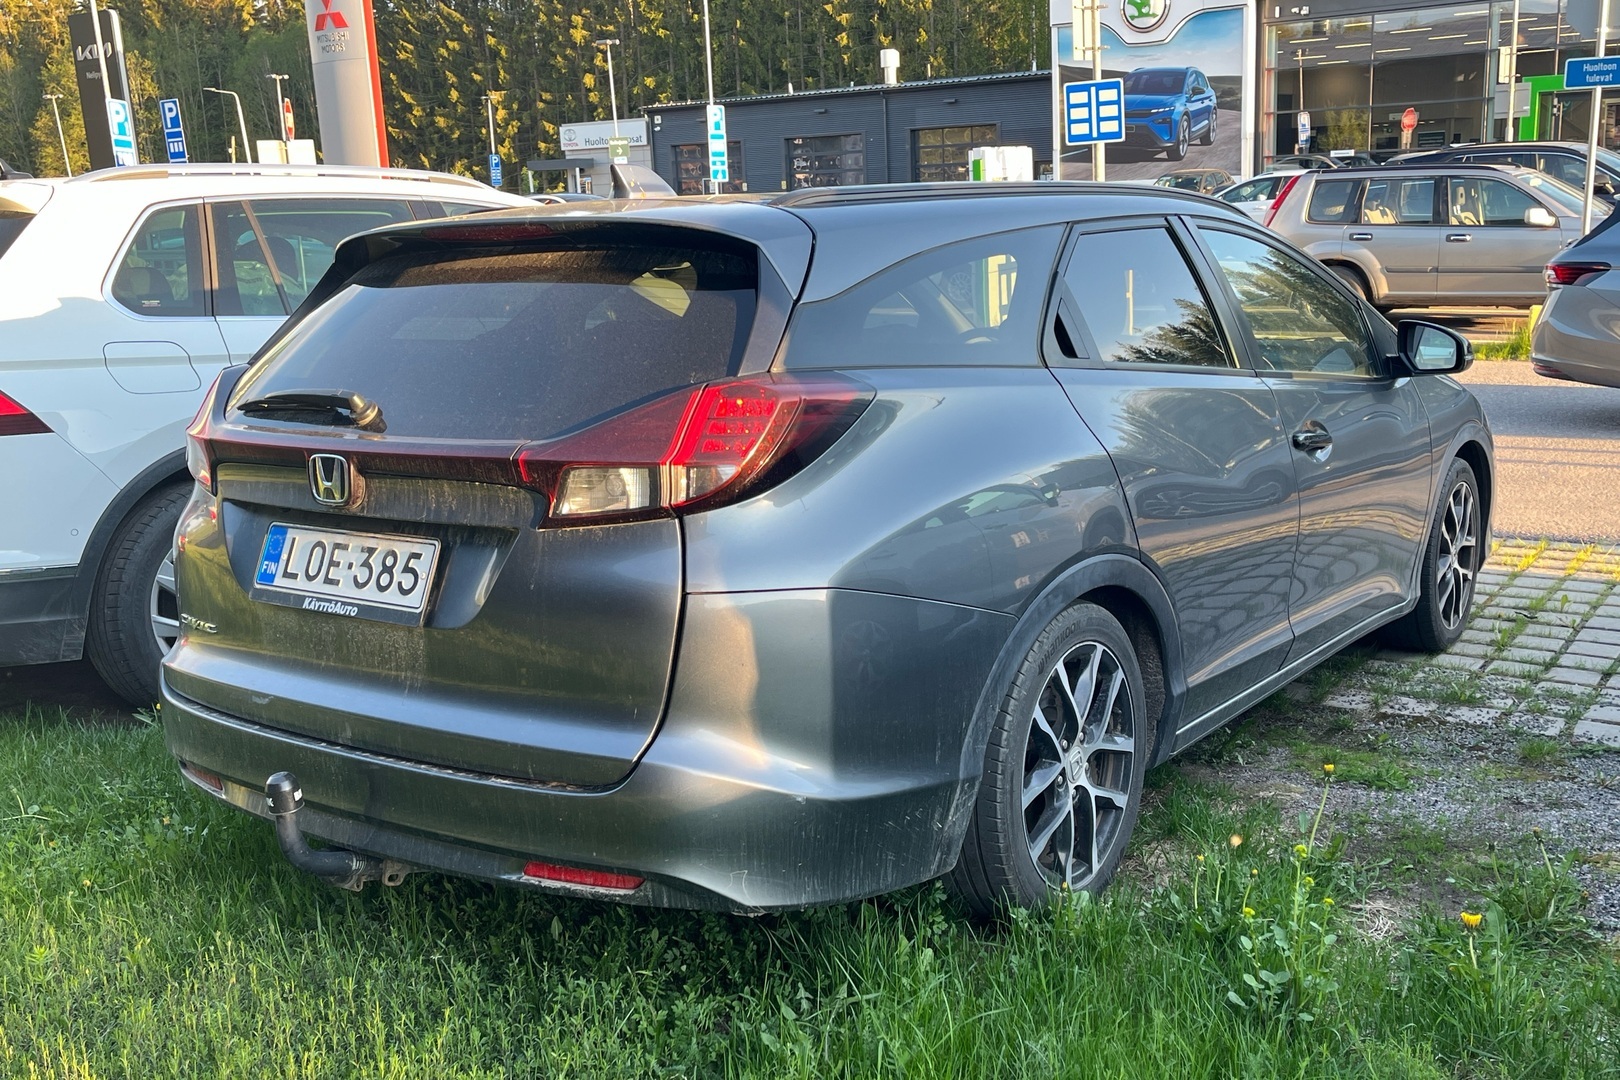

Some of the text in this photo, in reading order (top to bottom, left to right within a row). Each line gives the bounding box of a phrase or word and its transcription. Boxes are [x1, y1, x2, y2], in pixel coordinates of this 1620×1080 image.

[1583, 62, 1617, 72] Huoltoon
[1586, 73, 1613, 83] tulevat
[163, 102, 177, 128] P
[491, 156, 499, 168] P
[262, 561, 278, 575] FIN
